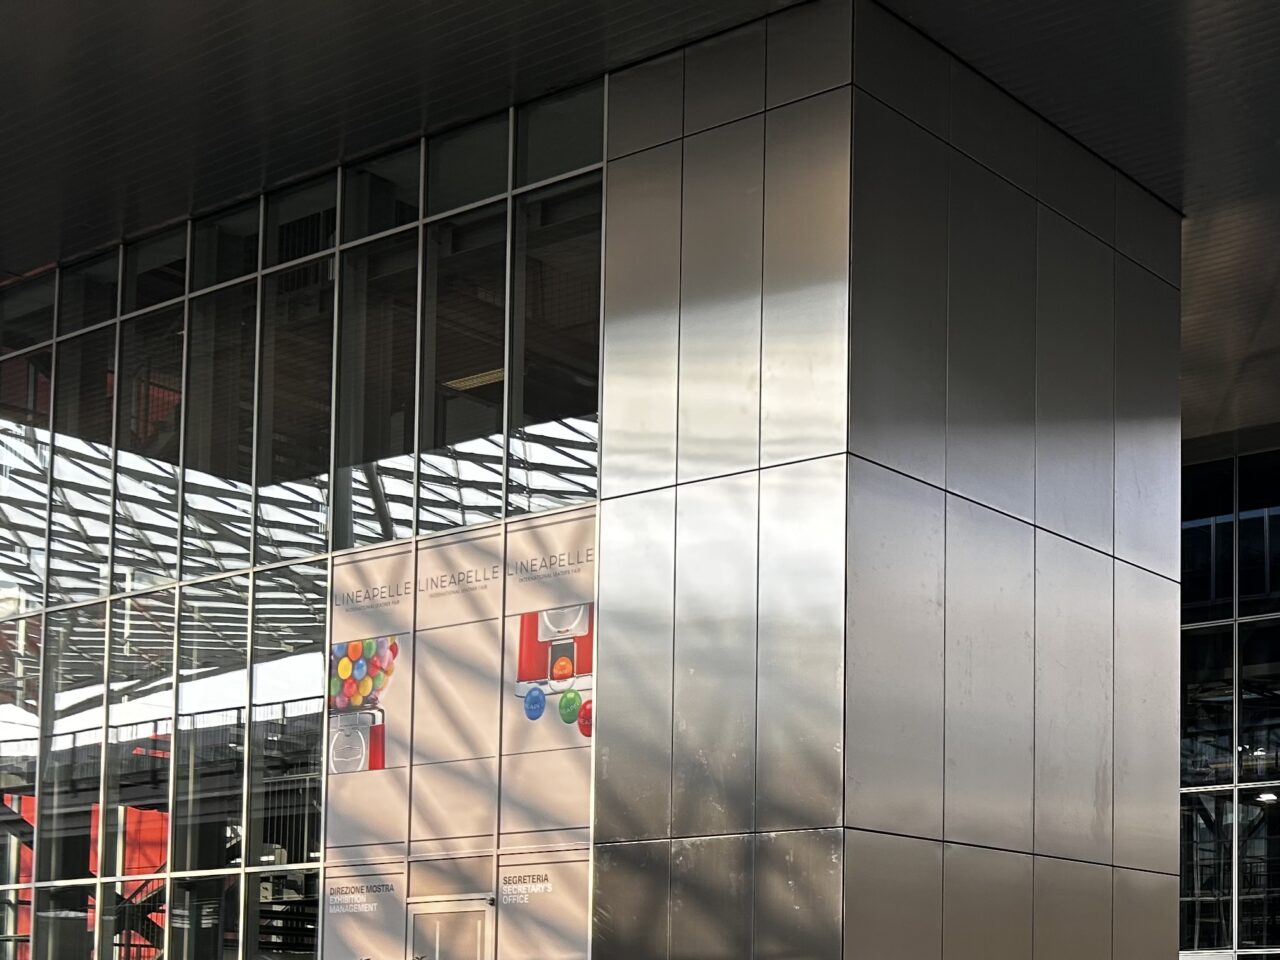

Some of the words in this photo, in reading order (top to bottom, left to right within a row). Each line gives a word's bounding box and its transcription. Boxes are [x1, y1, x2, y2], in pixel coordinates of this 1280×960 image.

[507, 548, 594, 576] LINEAPELLE
[418, 565, 499, 592] LINEAPELLE
[334, 582, 412, 607] LINEAPELLE
[502, 874, 549, 885] SEGRETERIA
[329, 885, 365, 895] DIREZIONE
[365, 884, 394, 893] MOSTRA
[502, 884, 553, 894] SECRETARY'S
[329, 894, 367, 904] EXHIBITION
[502, 894, 529, 904] OFFICE
[329, 903, 378, 913] MANAGEMENT
